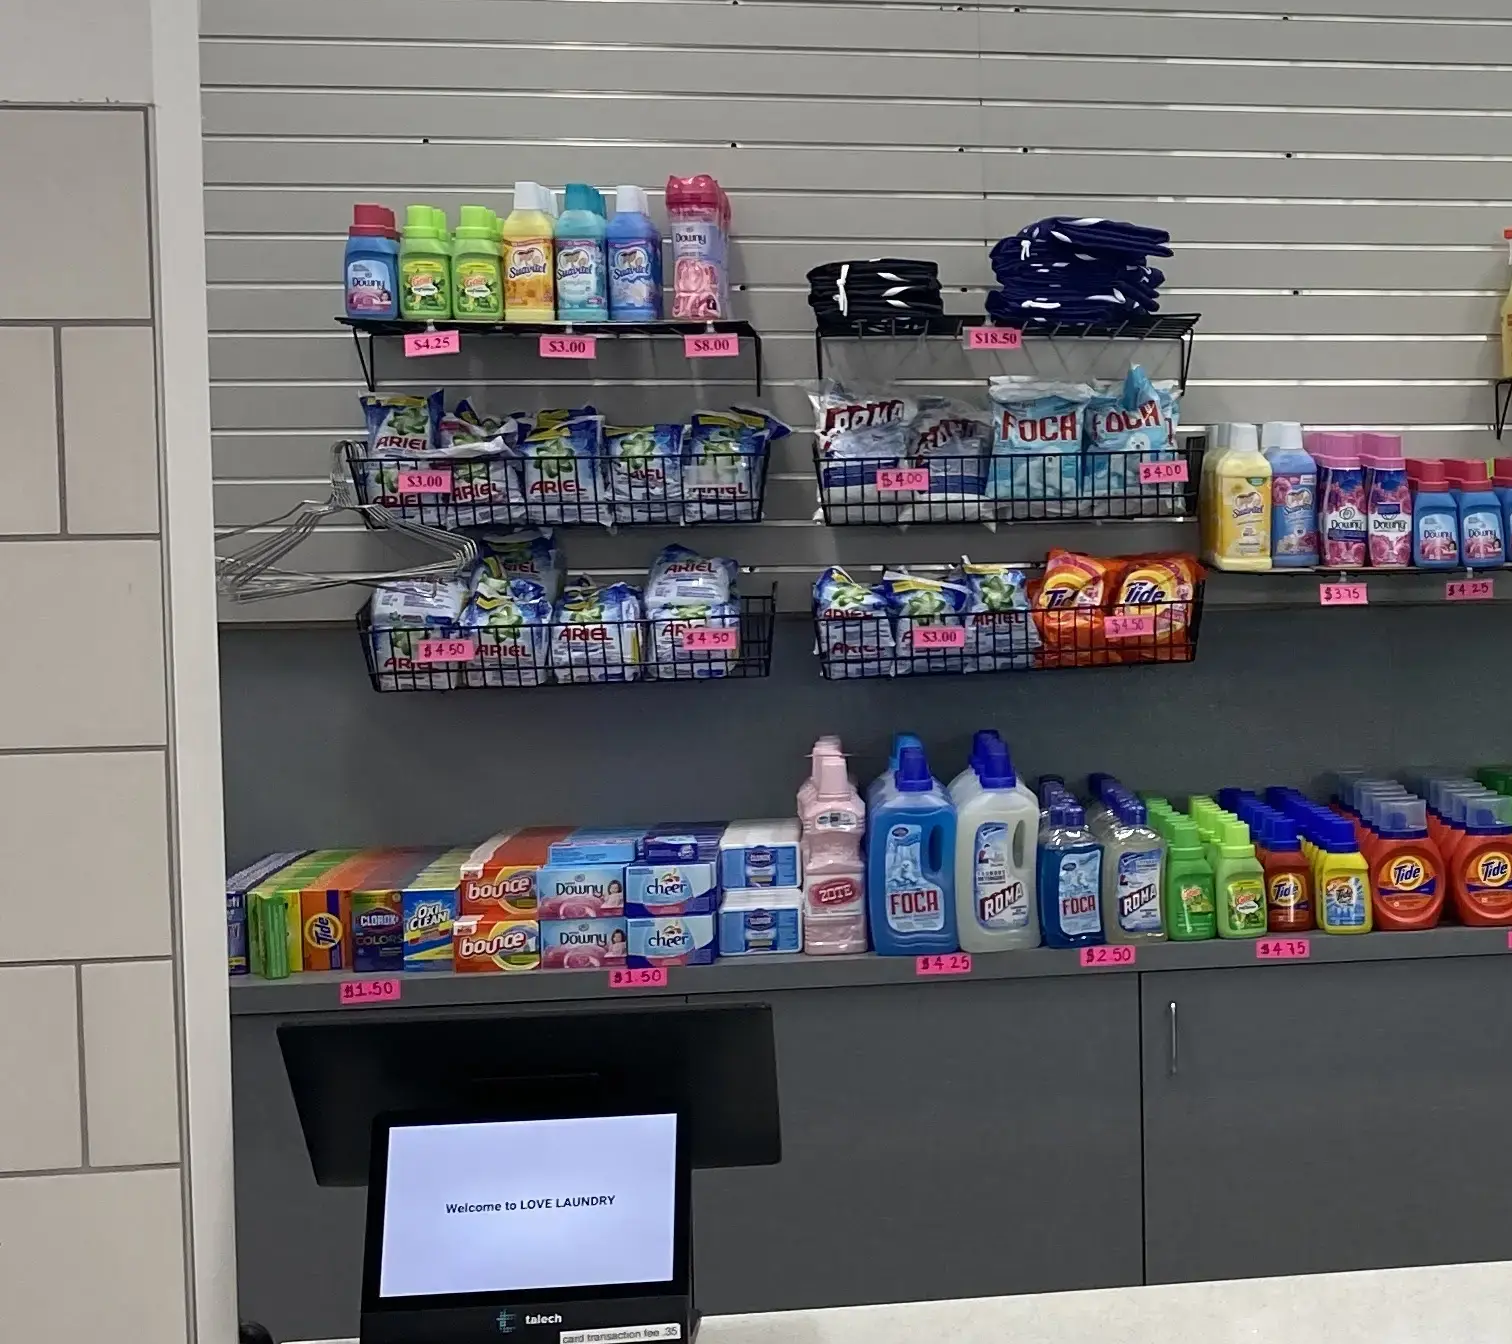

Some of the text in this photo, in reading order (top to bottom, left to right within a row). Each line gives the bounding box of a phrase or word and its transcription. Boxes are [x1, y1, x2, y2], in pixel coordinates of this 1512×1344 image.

[677, 233, 706, 244] Downy
[352, 276, 385, 290] Downy
[414, 336, 450, 351] $4.25
[549, 340, 586, 353] $3.00
[694, 340, 730, 352] $8.00
[975, 333, 1017, 344] $18.50
[1002, 410, 1078, 442] FOCA
[375, 435, 428, 450] ARIEL
[407, 475, 443, 488] $3.00
[663, 562, 718, 574] ARIEL
[1125, 581, 1166, 603] Tide
[558, 627, 614, 641] ARIEL
[922, 631, 957, 643] $3.00
[475, 645, 532, 657] ARIEL
[1393, 865, 1421, 885] Tide
[1481, 861, 1508, 881] Tide
[467, 876, 532, 901] bounce
[555, 881, 604, 898] Downy
[646, 877, 688, 896] cheer
[819, 884, 853, 902] ZOTE
[1273, 882, 1299, 900] Tide
[890, 890, 939, 915] FOCA
[979, 881, 1024, 922] ROMA
[1062, 894, 1096, 916] FOCA
[1119, 883, 1158, 918] ROMA
[418, 904, 440, 919] OXI
[314, 916, 336, 947] Tide
[559, 932, 608, 947] Downy
[647, 930, 689, 948] cheer
[461, 931, 526, 957] bounce
[343, 981, 393, 999] $1.50
[446, 1195, 616, 1214] Welcome to LOVE LAUNDRY
[525, 1313, 562, 1324] talech
[562, 1333, 585, 1344] card
[586, 1330, 642, 1343] transaction
